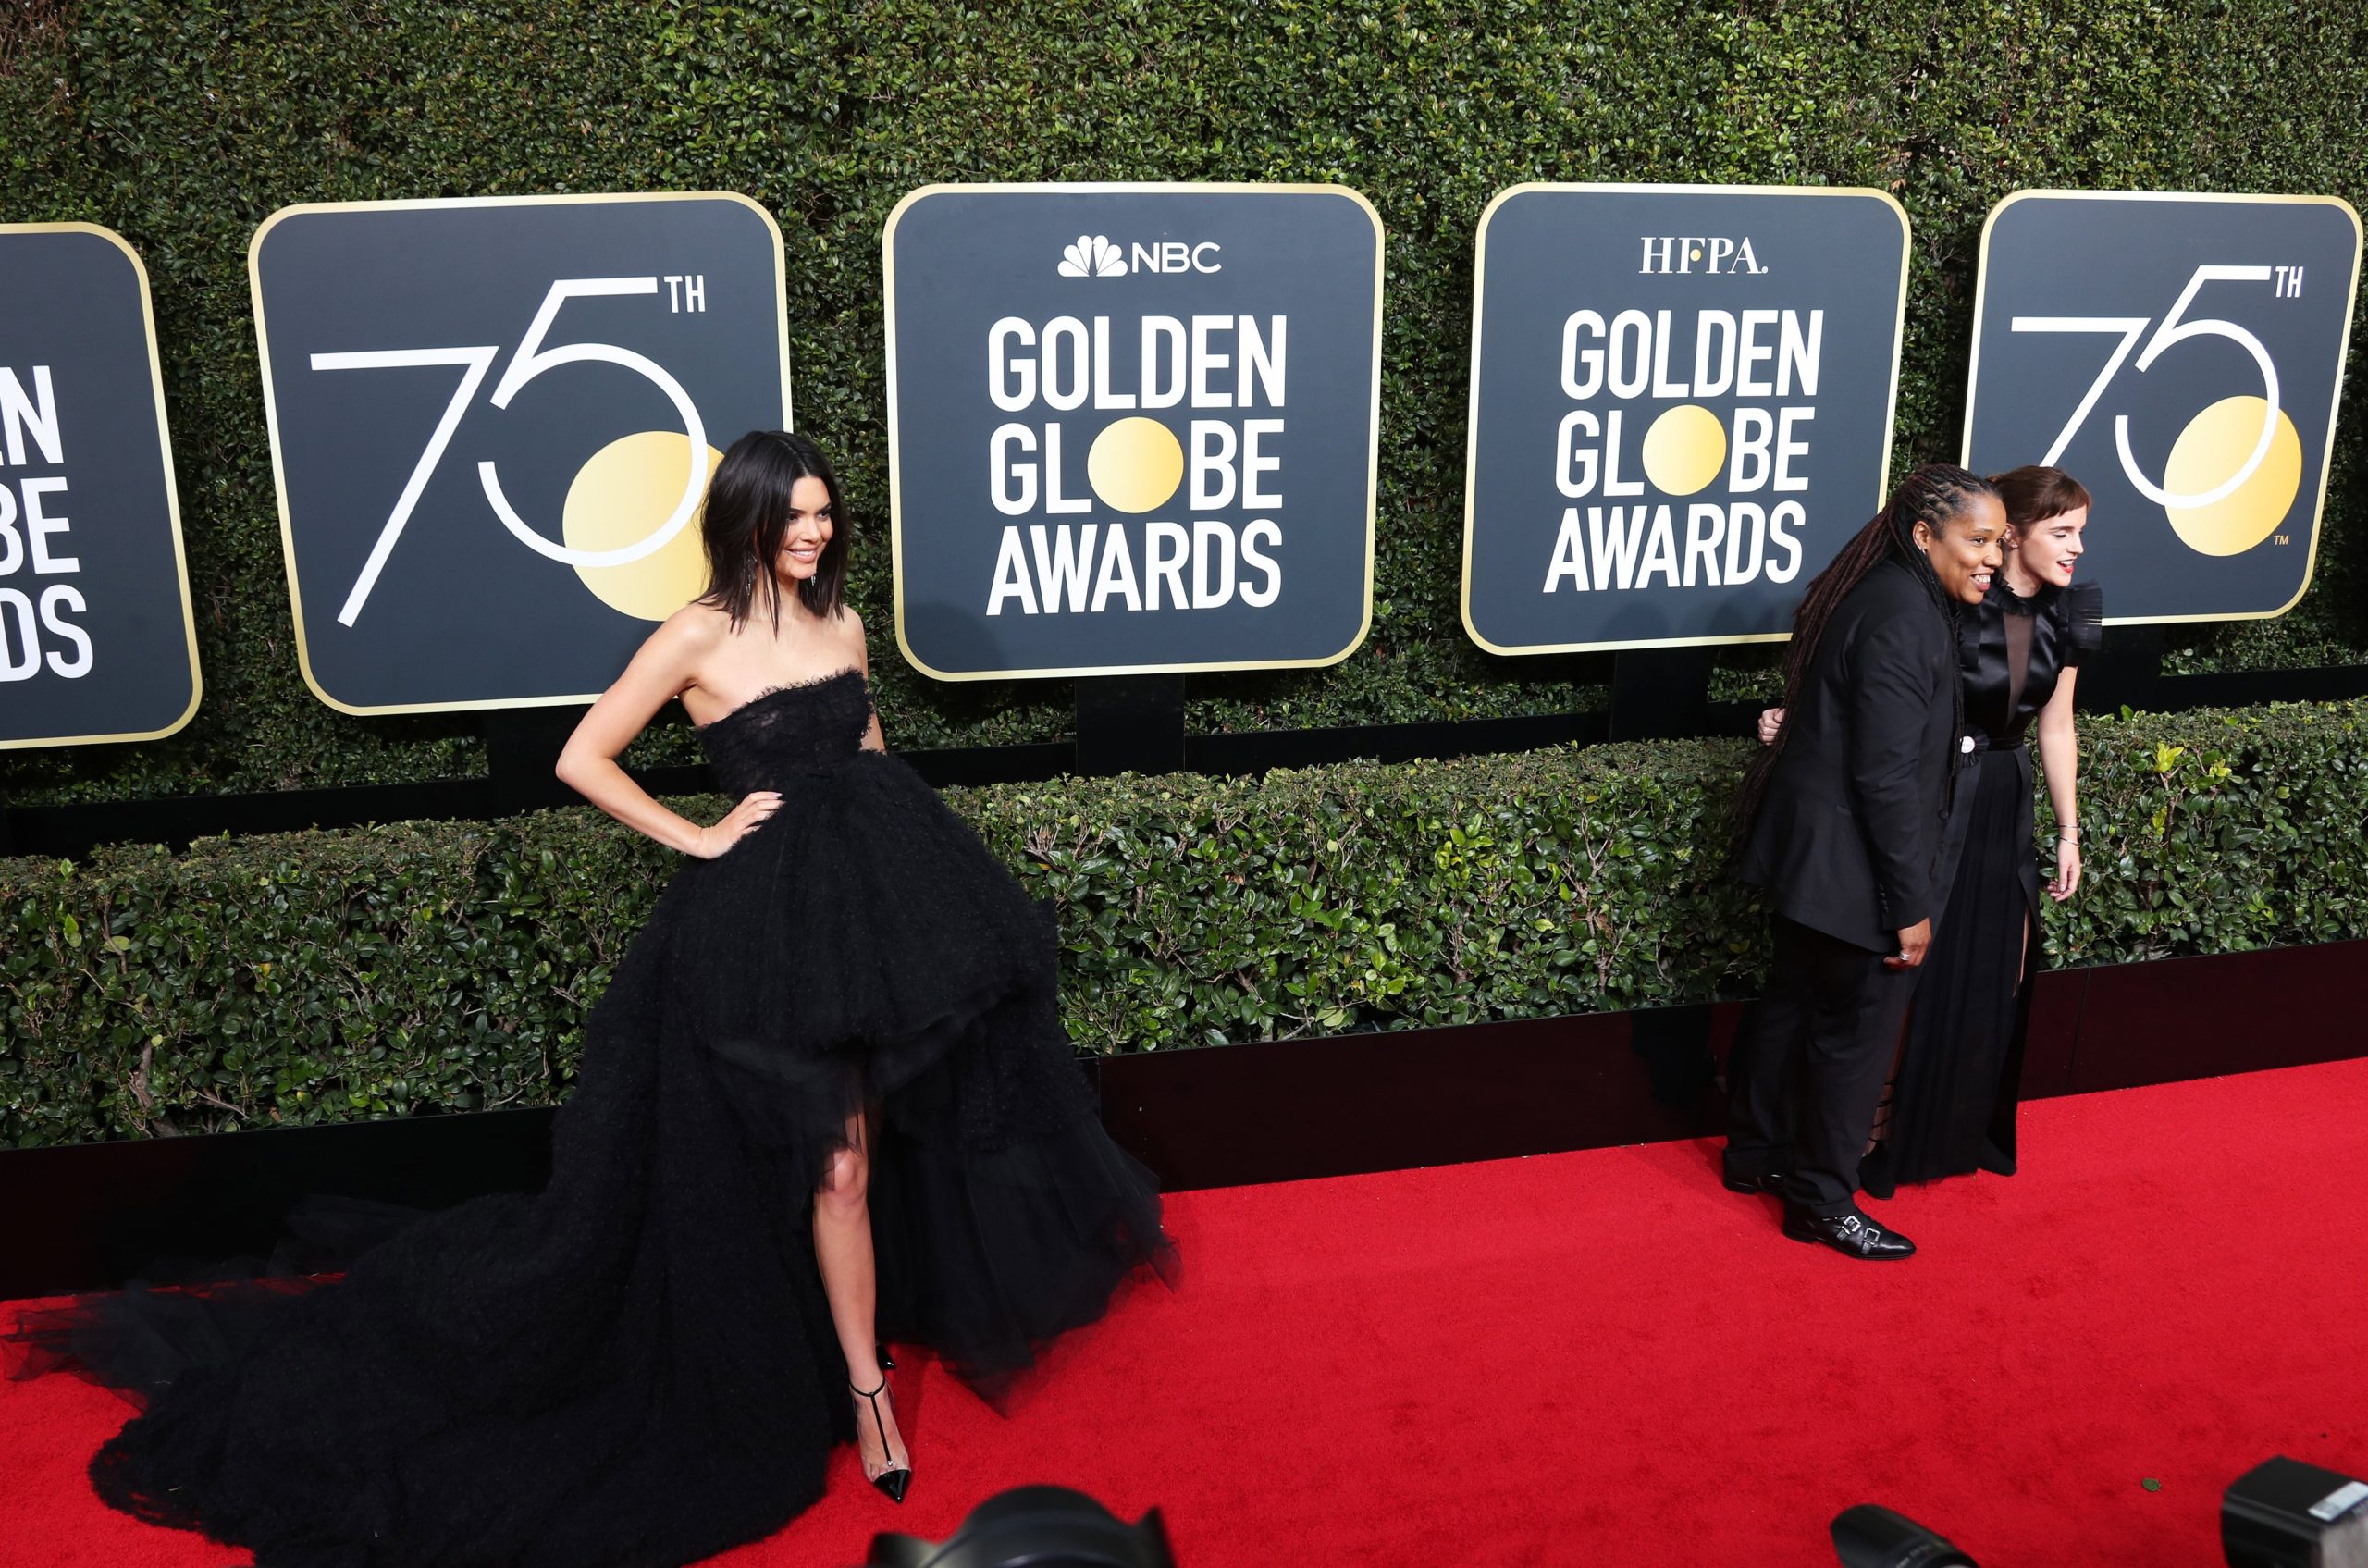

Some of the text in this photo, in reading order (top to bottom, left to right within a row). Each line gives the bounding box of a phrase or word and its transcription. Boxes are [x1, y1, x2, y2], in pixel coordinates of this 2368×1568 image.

[1131, 241, 1222, 274] NBC
[988, 315, 1287, 413] GOLDEN
[1560, 309, 1824, 401] GOLDEN
[0, 365, 64, 465] N
[985, 518, 1283, 616] AWARDS
[1542, 500, 1807, 593] AWARDS
